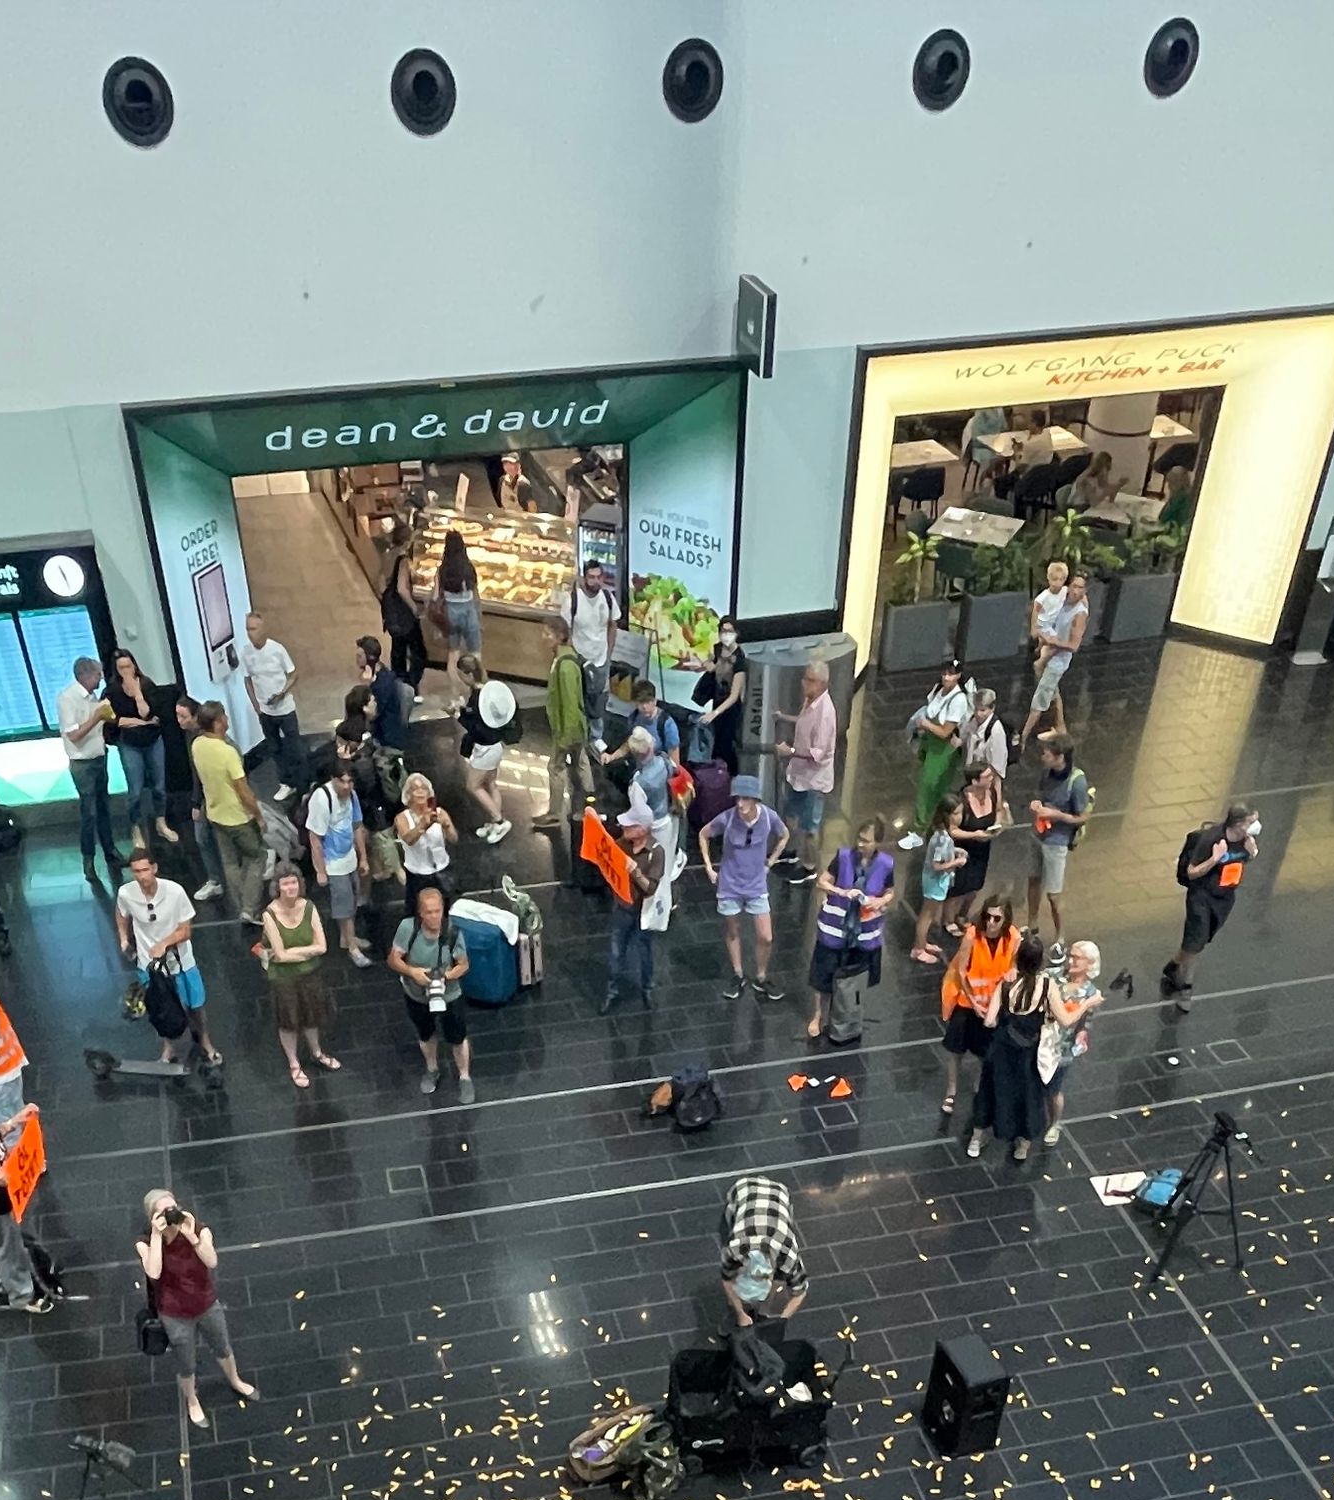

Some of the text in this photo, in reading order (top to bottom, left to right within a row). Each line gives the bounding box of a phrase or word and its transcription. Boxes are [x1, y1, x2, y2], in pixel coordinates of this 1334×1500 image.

[955, 342, 1244, 380] WOLFGANG PUCK
[1046, 366, 1153, 385] KITCHEN
[1178, 359, 1225, 373] BAR
[265, 400, 609, 451] dean & david
[180, 520, 218, 551] ORDER
[639, 519, 722, 553] OUR FRESH
[186, 542, 219, 573] HERE!
[649, 541, 712, 569] SALADS?
[749, 687, 763, 736] Abfall
